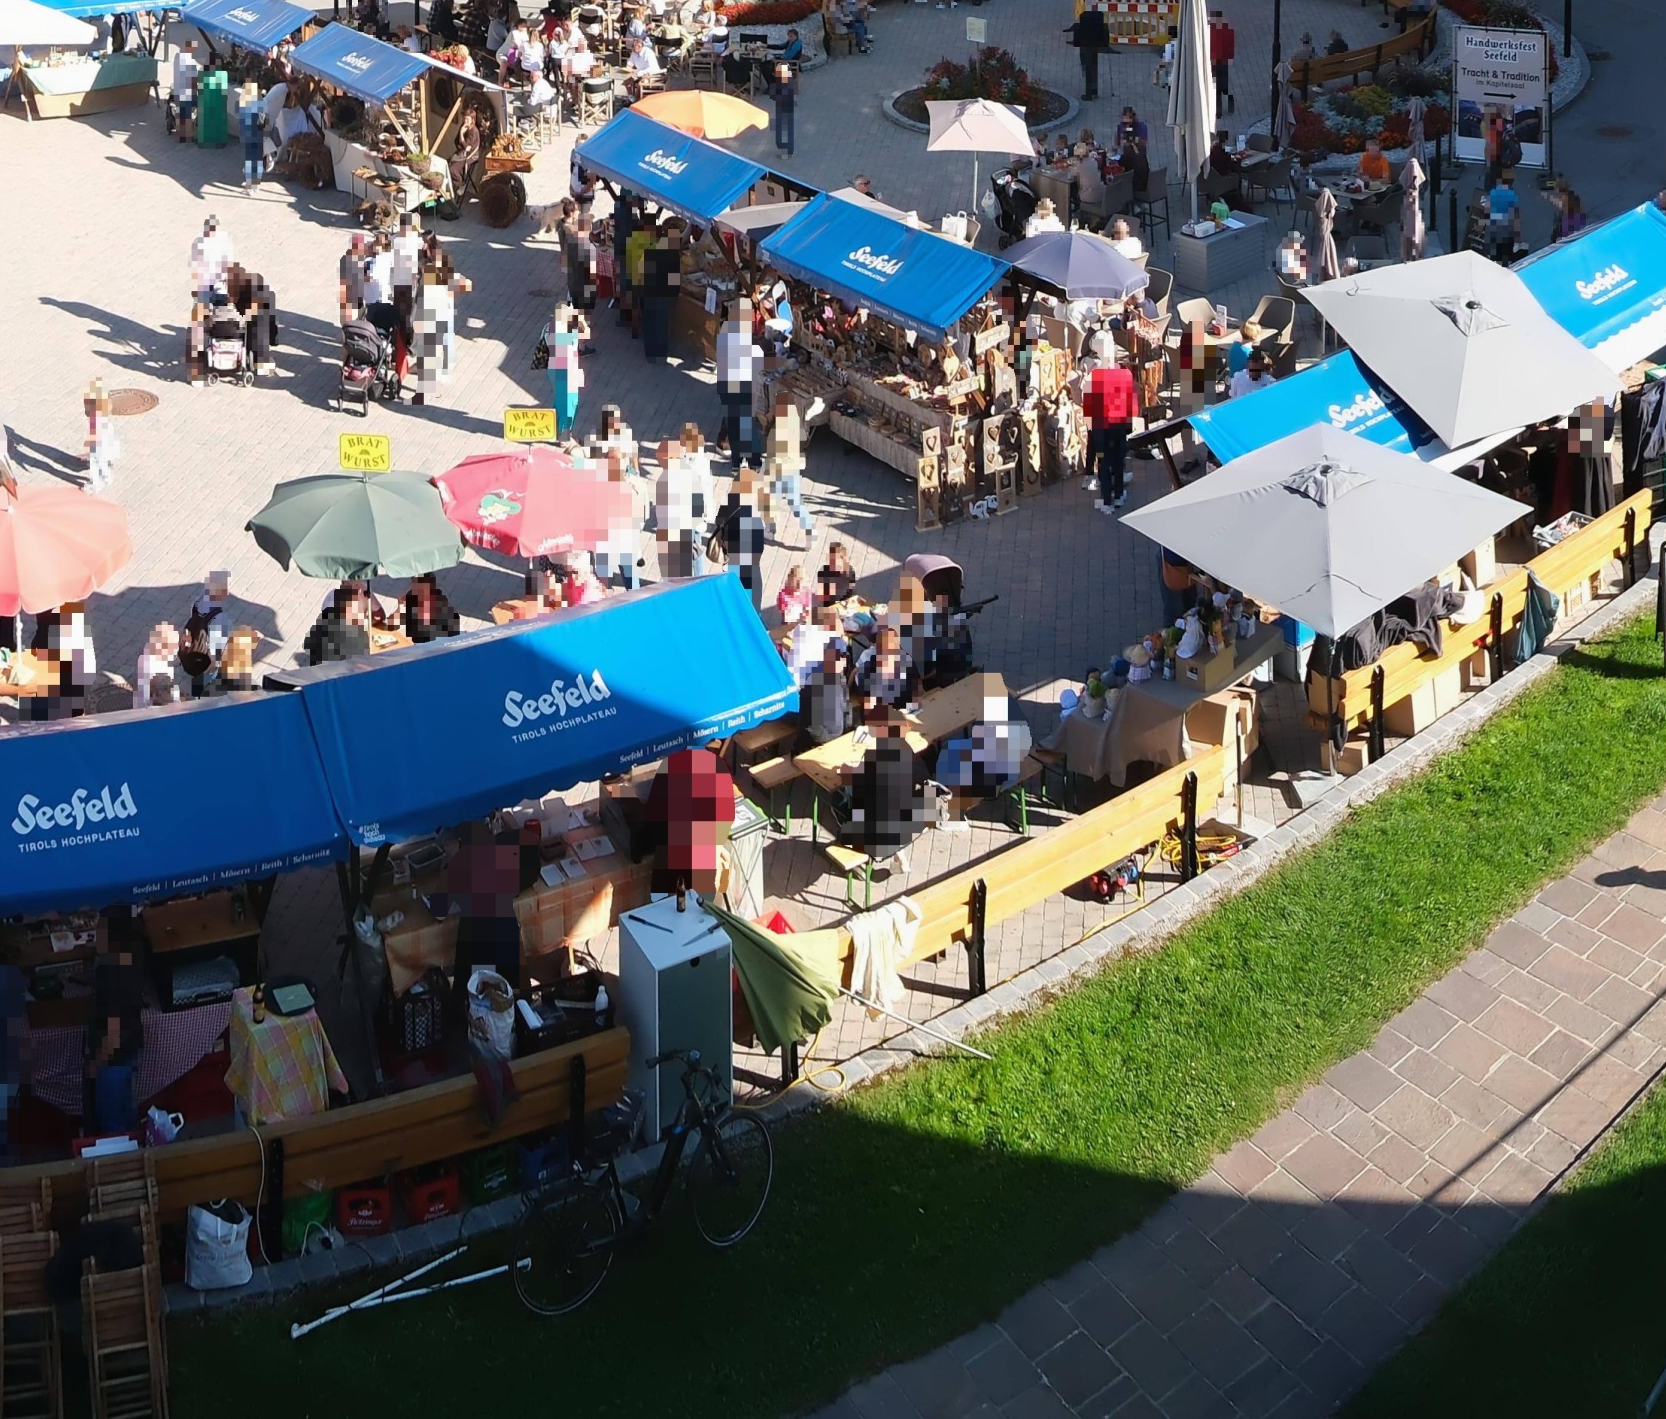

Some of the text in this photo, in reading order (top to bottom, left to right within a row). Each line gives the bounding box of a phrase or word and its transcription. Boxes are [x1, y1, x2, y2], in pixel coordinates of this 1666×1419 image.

[1466, 36, 1537, 51] Handwerksfest
[1484, 50, 1517, 62] Seefeld
[1461, 67, 1540, 82] Tracht & Tradition
[644, 149, 689, 174] Seefeld
[849, 245, 904, 275] Seefeld
[1575, 263, 1630, 301] Seefeld
[513, 410, 548, 421] BRAT
[348, 436, 382, 449] BRAT
[508, 424, 551, 438] WURST
[343, 452, 385, 468] WURST
[502, 668, 611, 728] Seefeld
[511, 707, 618, 744] TIROLS HOCHPLATEAU
[619, 749, 644, 764] Seefeld
[653, 736, 684, 753] Leutasch
[693, 725, 719, 740] Mösern
[753, 700, 785, 719] Scharnitz
[11, 782, 138, 835] Seefeld
[18, 827, 140, 853] TIROLS HOCHPLATEAU
[132, 847, 331, 896] Seefeld Leutasch Mösern Reith Scharnitz
